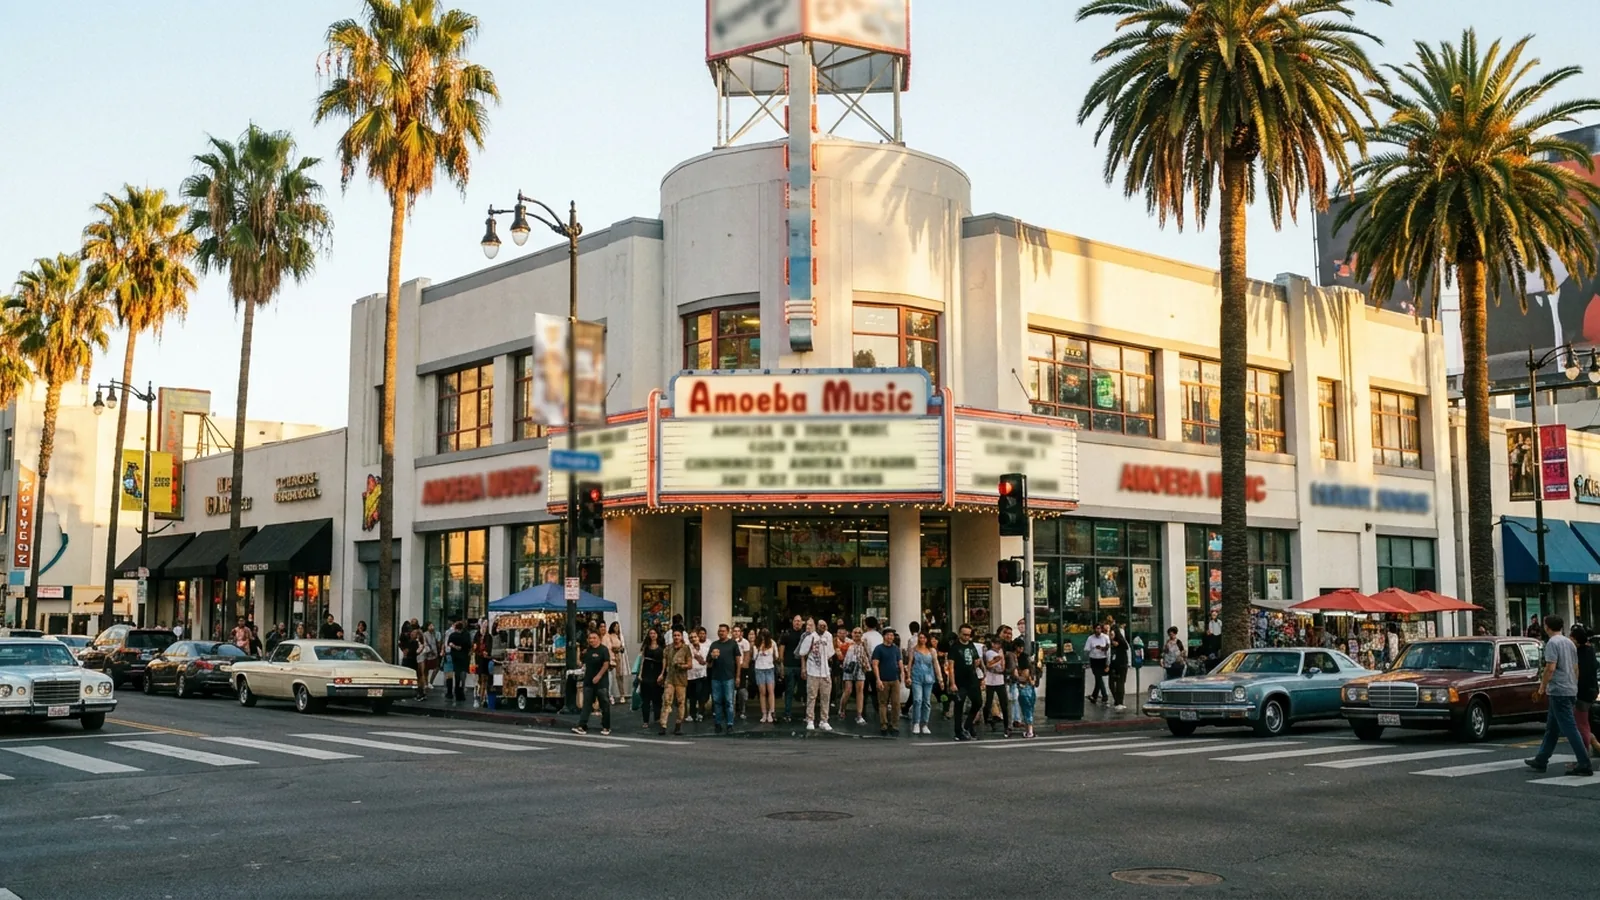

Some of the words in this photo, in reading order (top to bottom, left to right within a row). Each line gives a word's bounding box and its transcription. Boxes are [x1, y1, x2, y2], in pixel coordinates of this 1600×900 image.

[689, 380, 807, 414] Amoeba
[822, 380, 913, 413] Music
[1207, 471, 1267, 503] MIC
